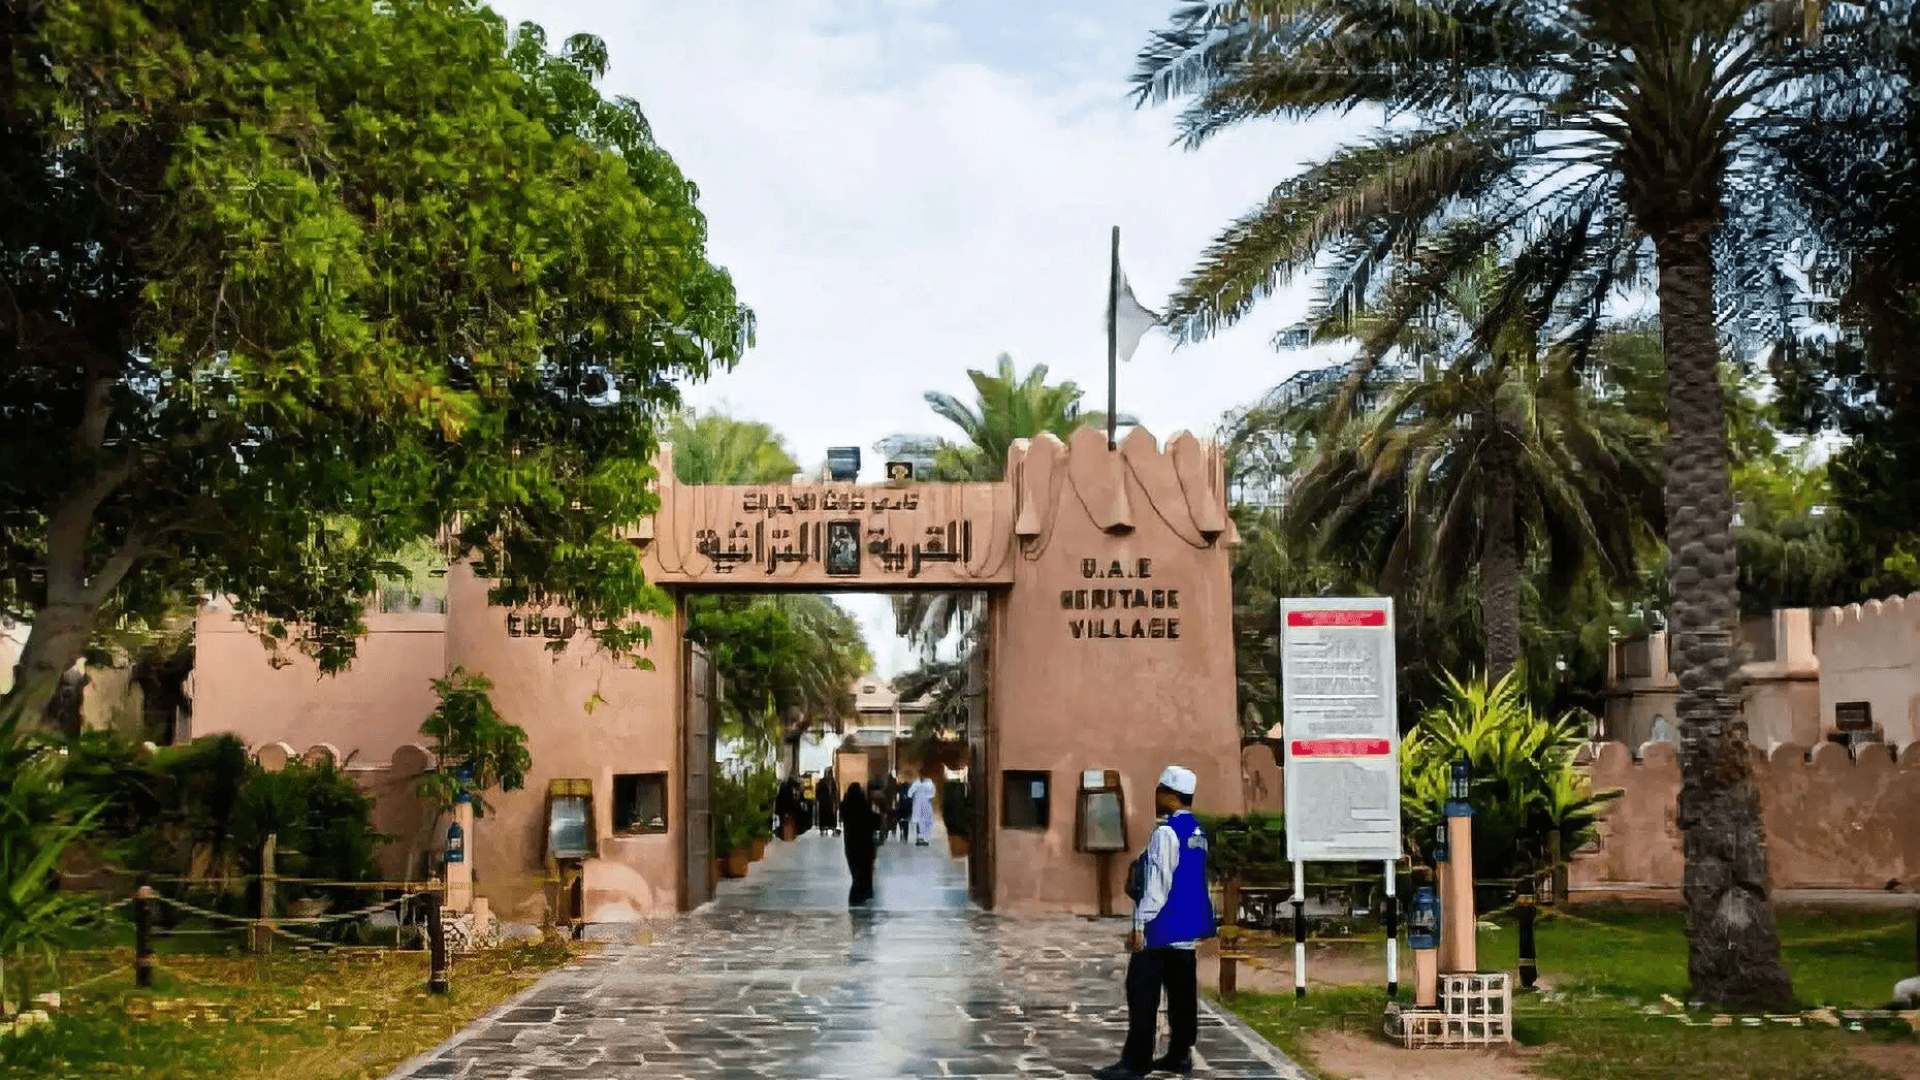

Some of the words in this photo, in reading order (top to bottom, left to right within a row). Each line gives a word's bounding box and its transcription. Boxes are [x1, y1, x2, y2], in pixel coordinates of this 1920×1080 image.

[695, 519, 821, 576] التراثية
[867, 519, 972, 578] القرية
[1060, 588, 1180, 610] HERITAGE
[1069, 617, 1180, 639] VILLAGE
